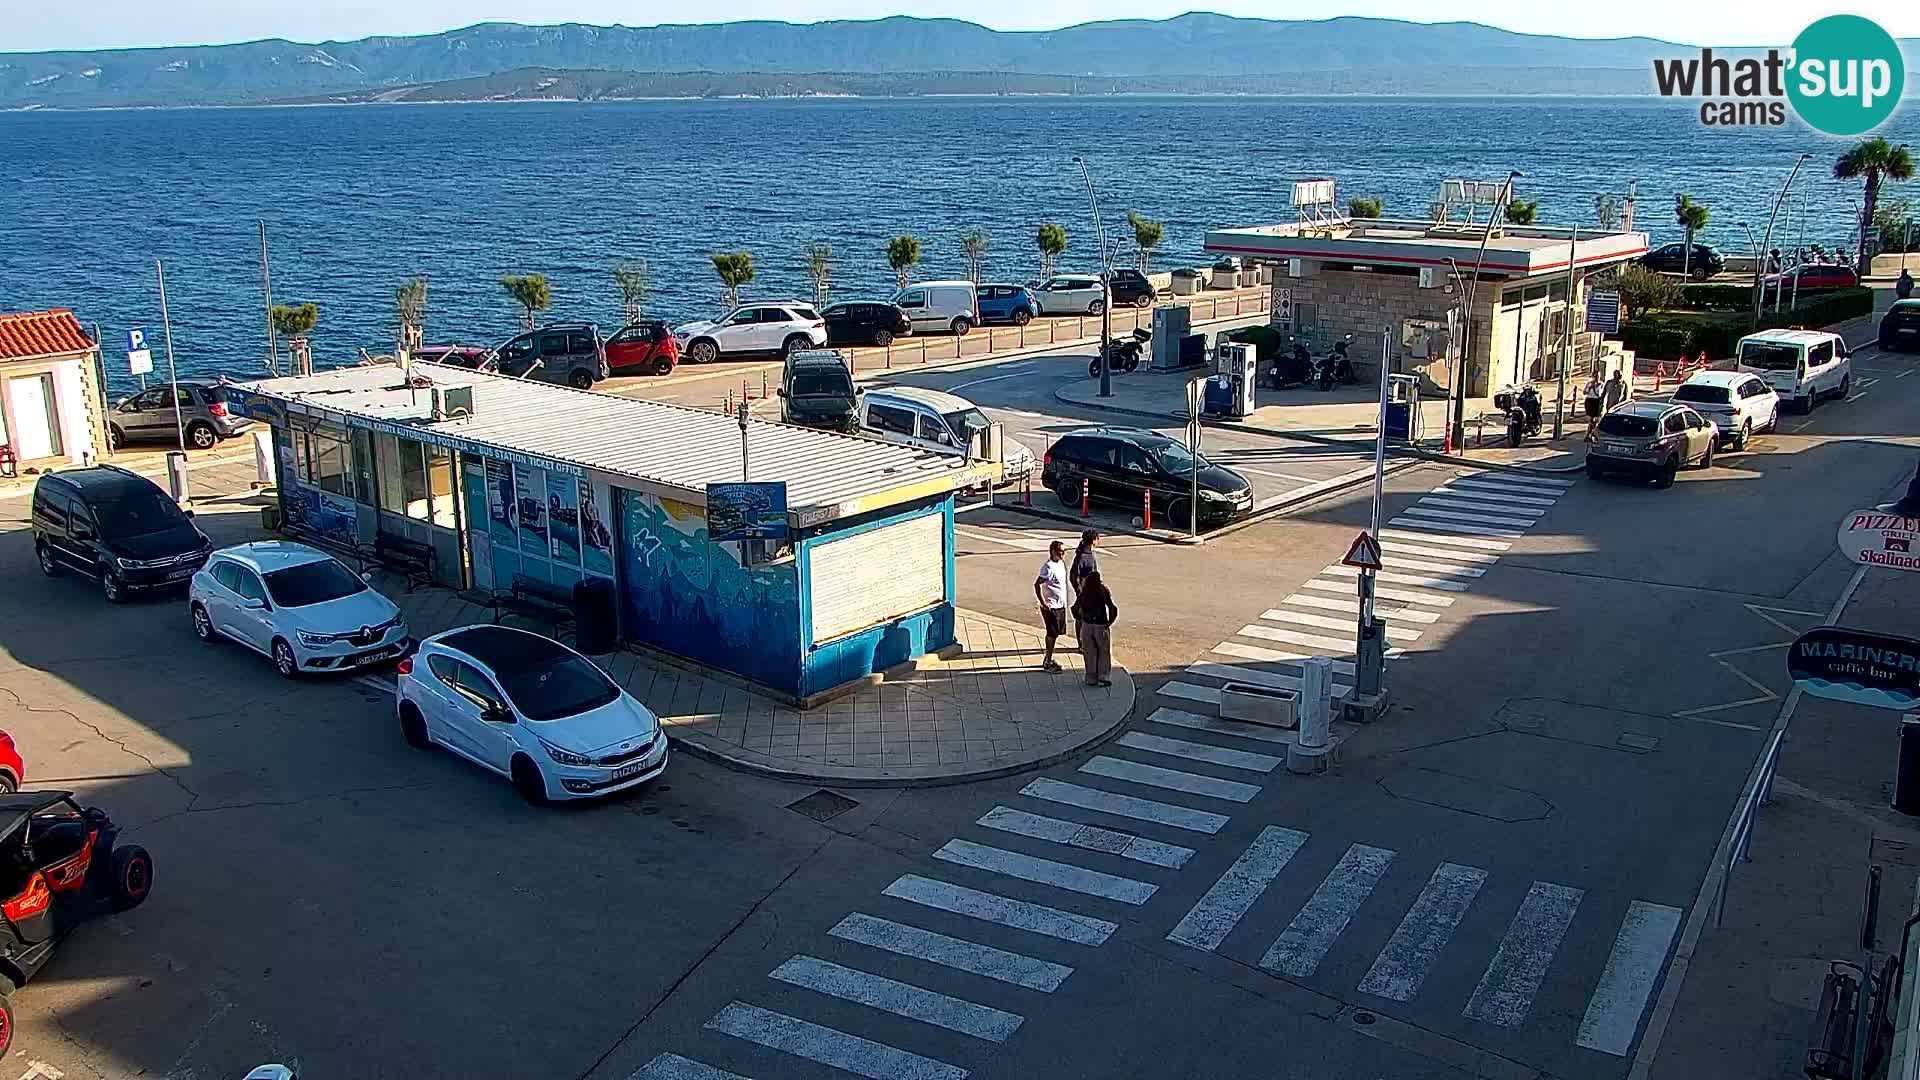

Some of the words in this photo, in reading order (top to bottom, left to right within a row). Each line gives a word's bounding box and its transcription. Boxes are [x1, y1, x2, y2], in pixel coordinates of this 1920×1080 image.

[131, 330, 144, 349] P
[436, 436, 469, 452] POSTAJA
[479, 445, 494, 458] BUS
[495, 450, 527, 465] STATION
[529, 457, 555, 471] TICKET
[556, 462, 583, 477] OFFICE
[1848, 516, 1920, 533] PIZZE
[1881, 530, 1917, 540] GRILL
[1870, 665, 1897, 680] bar
